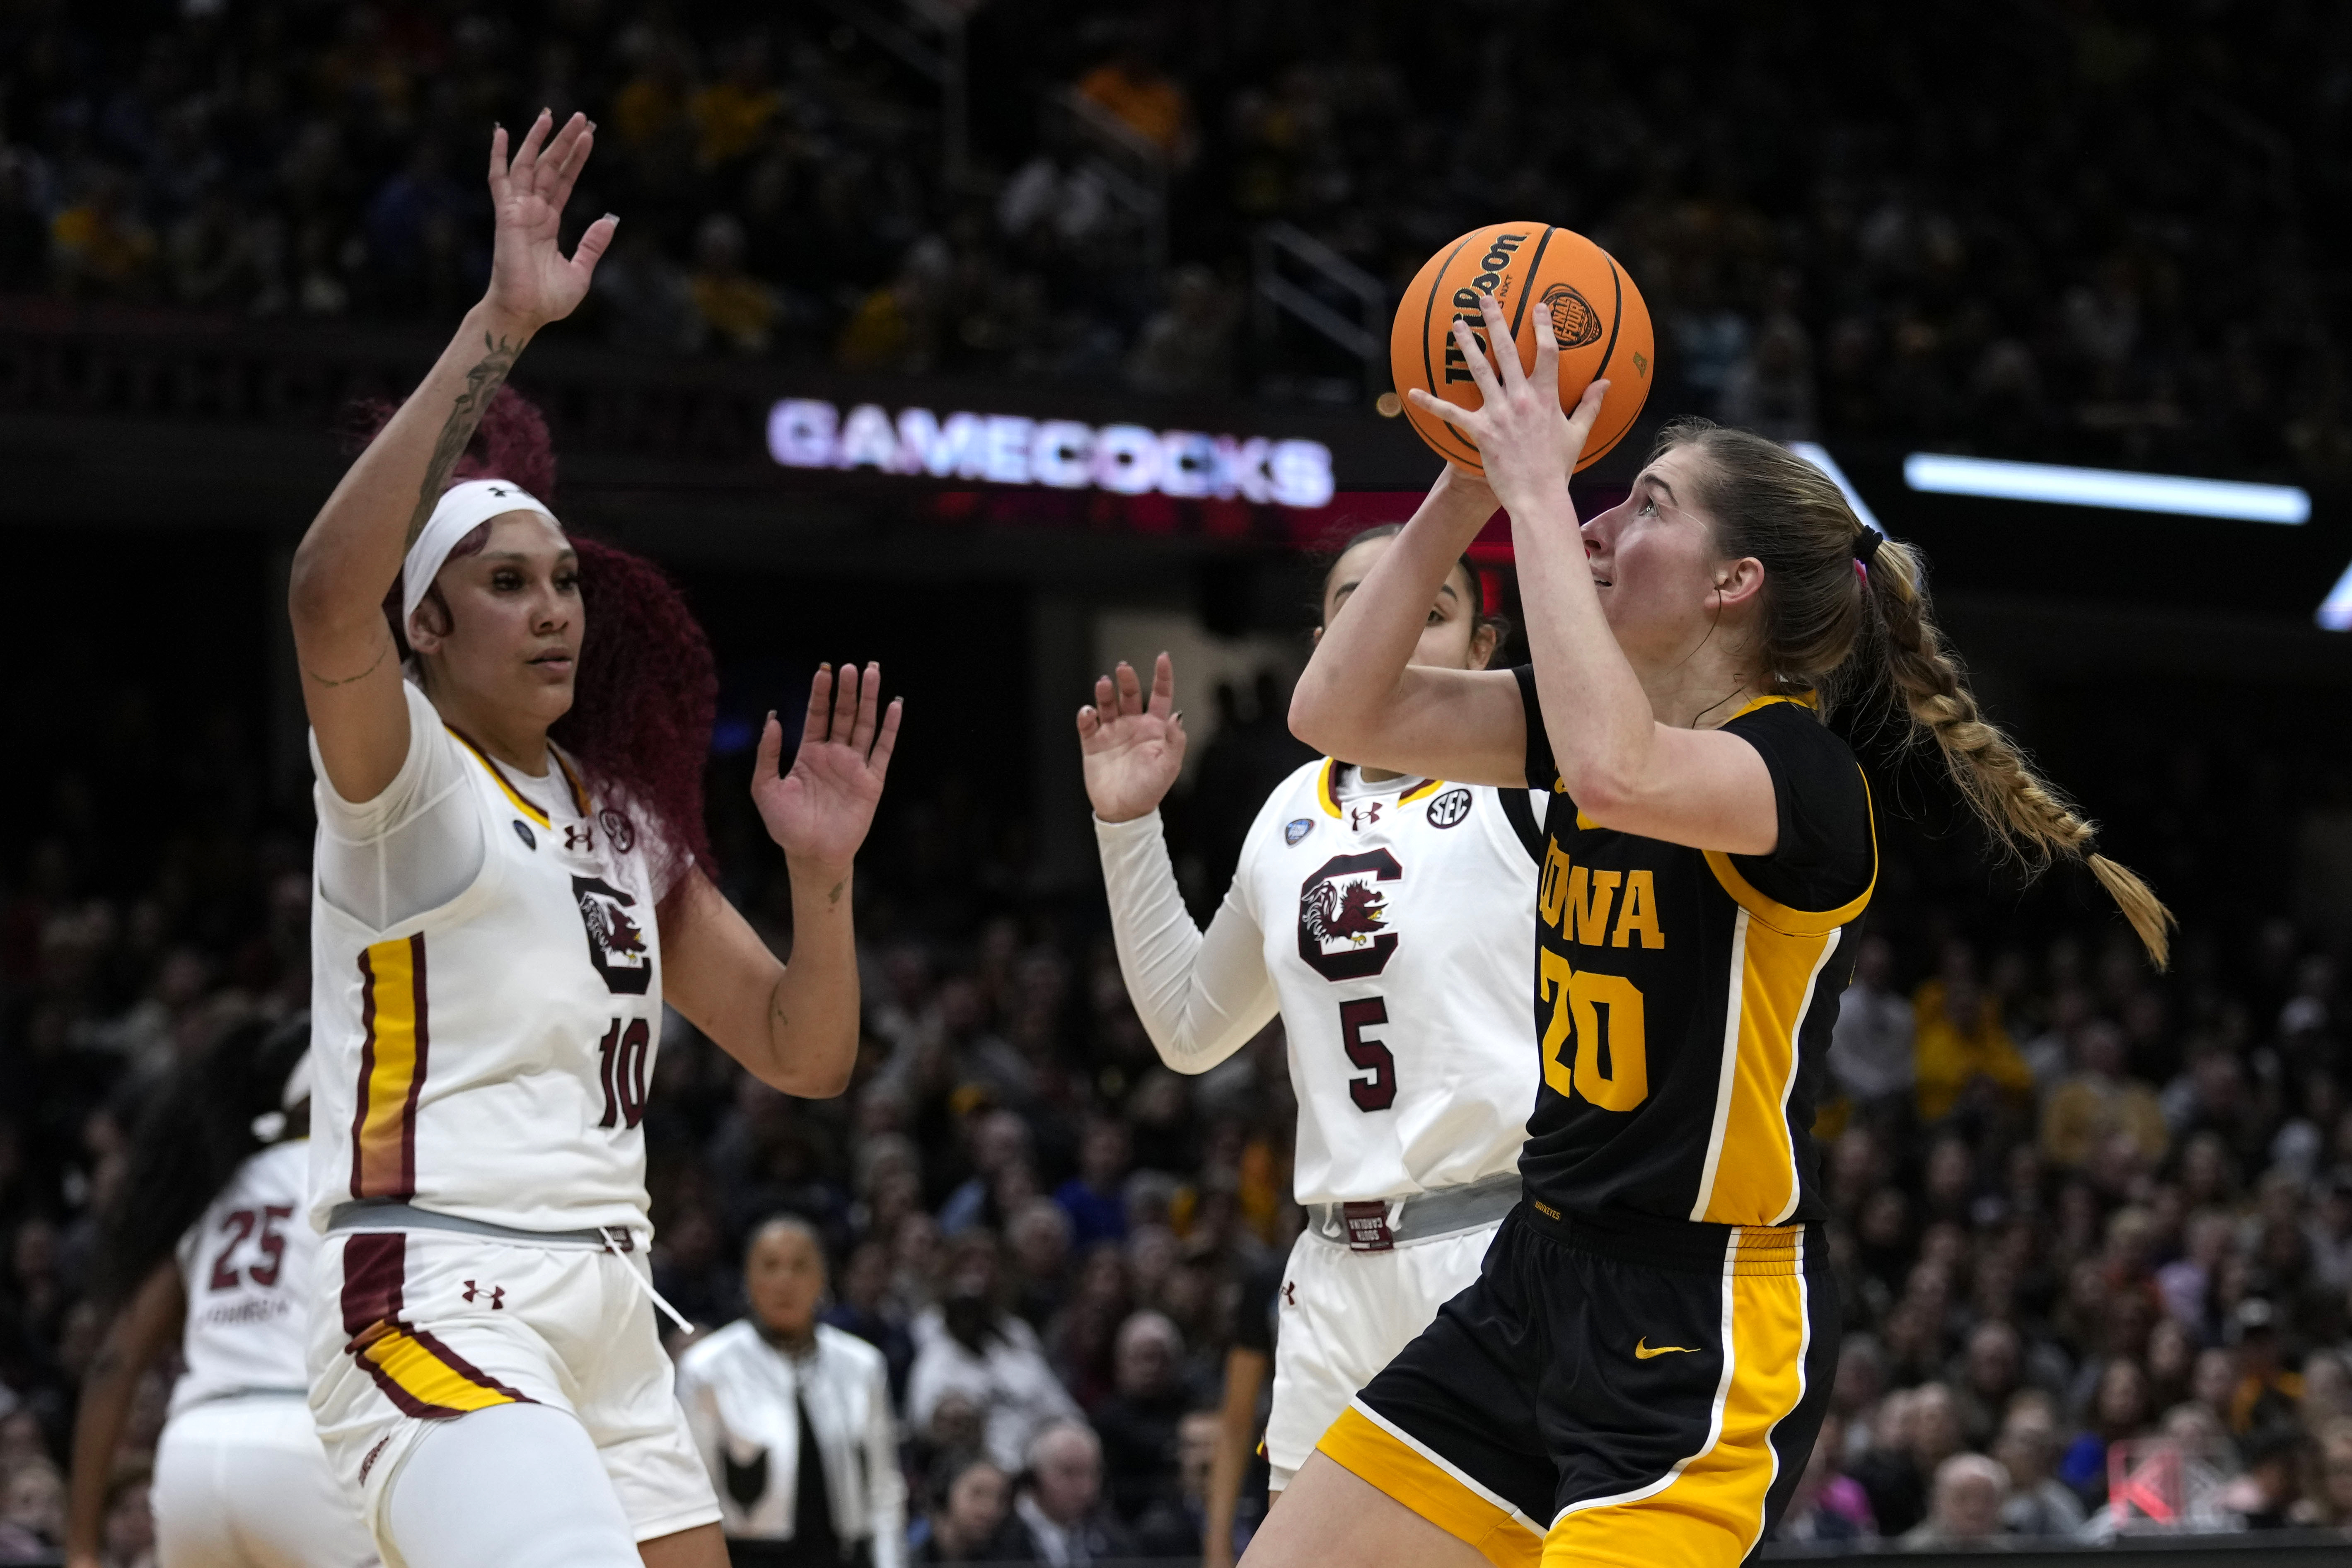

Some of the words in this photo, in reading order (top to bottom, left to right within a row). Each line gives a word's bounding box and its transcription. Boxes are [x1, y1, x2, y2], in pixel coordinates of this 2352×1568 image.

[1500, 274, 1513, 297] NXT
[1552, 296, 1571, 337] FINAL
[1562, 302, 1584, 341] FOUR
[766, 398, 1335, 508] GAMECOCKS
[1429, 790, 1469, 825] SEC
[1339, 996, 1397, 1113] 5
[1540, 945, 1648, 1112] 20
[598, 1018, 650, 1129] 10
[1534, 1200, 1560, 1220] HAWKEYES
[208, 1205, 293, 1291] 25
